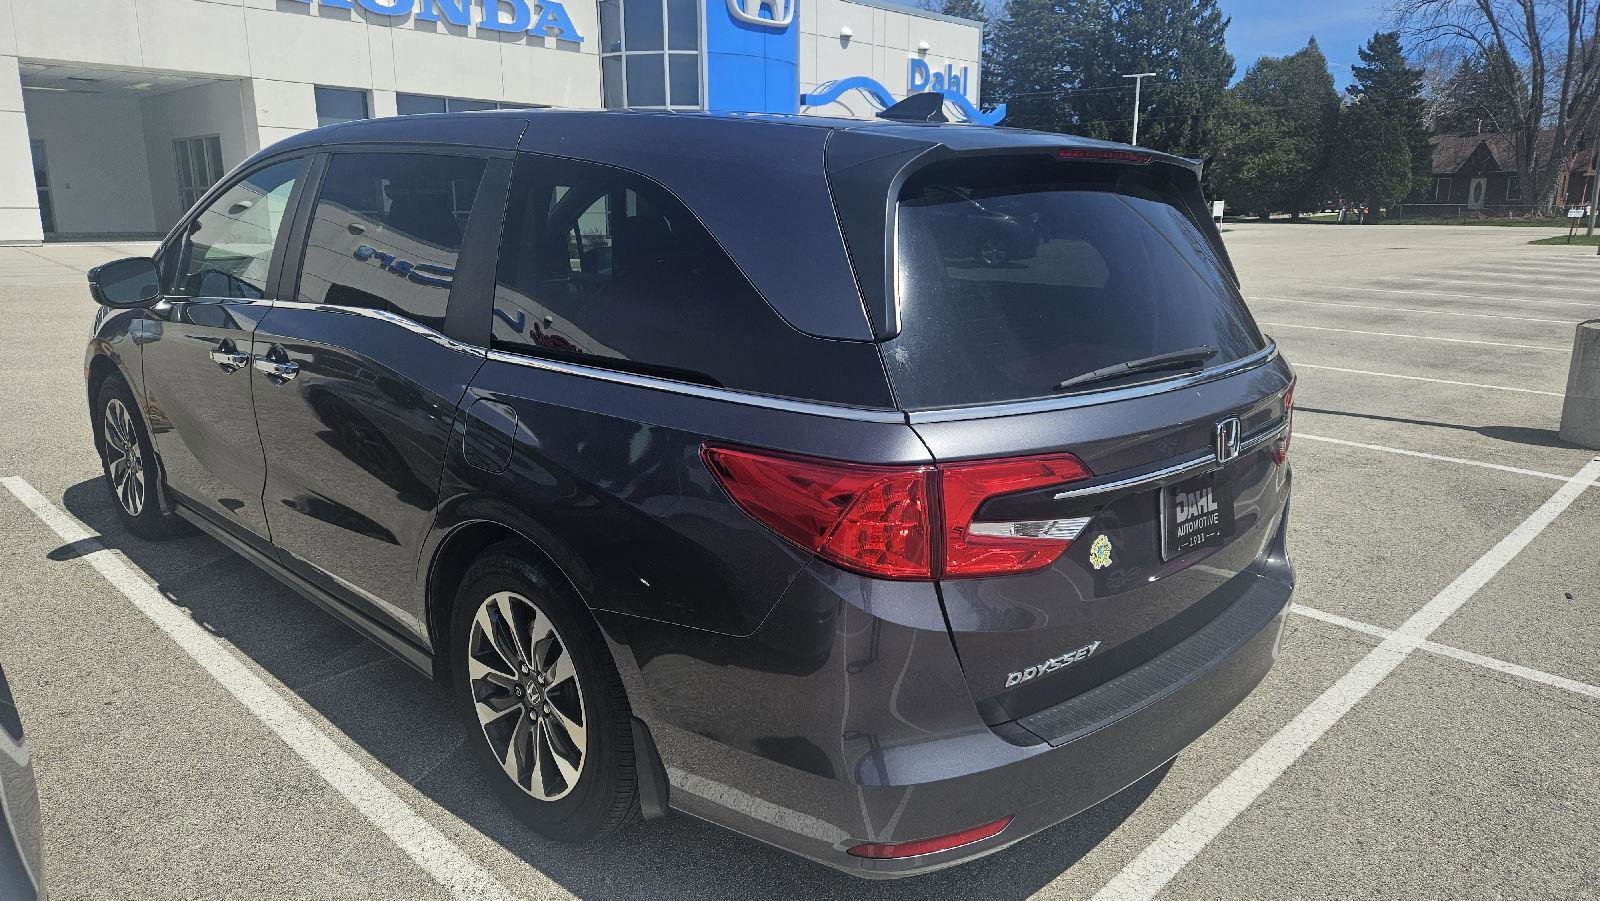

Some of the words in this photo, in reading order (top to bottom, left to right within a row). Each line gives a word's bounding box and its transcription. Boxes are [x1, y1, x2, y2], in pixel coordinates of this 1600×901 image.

[280, 0, 584, 43] NDA
[908, 57, 968, 97] Dahl
[1175, 486, 1218, 524] DAHL
[1177, 512, 1219, 538] AUTOMOTIVE
[1005, 640, 1102, 688] ODYSSEY
